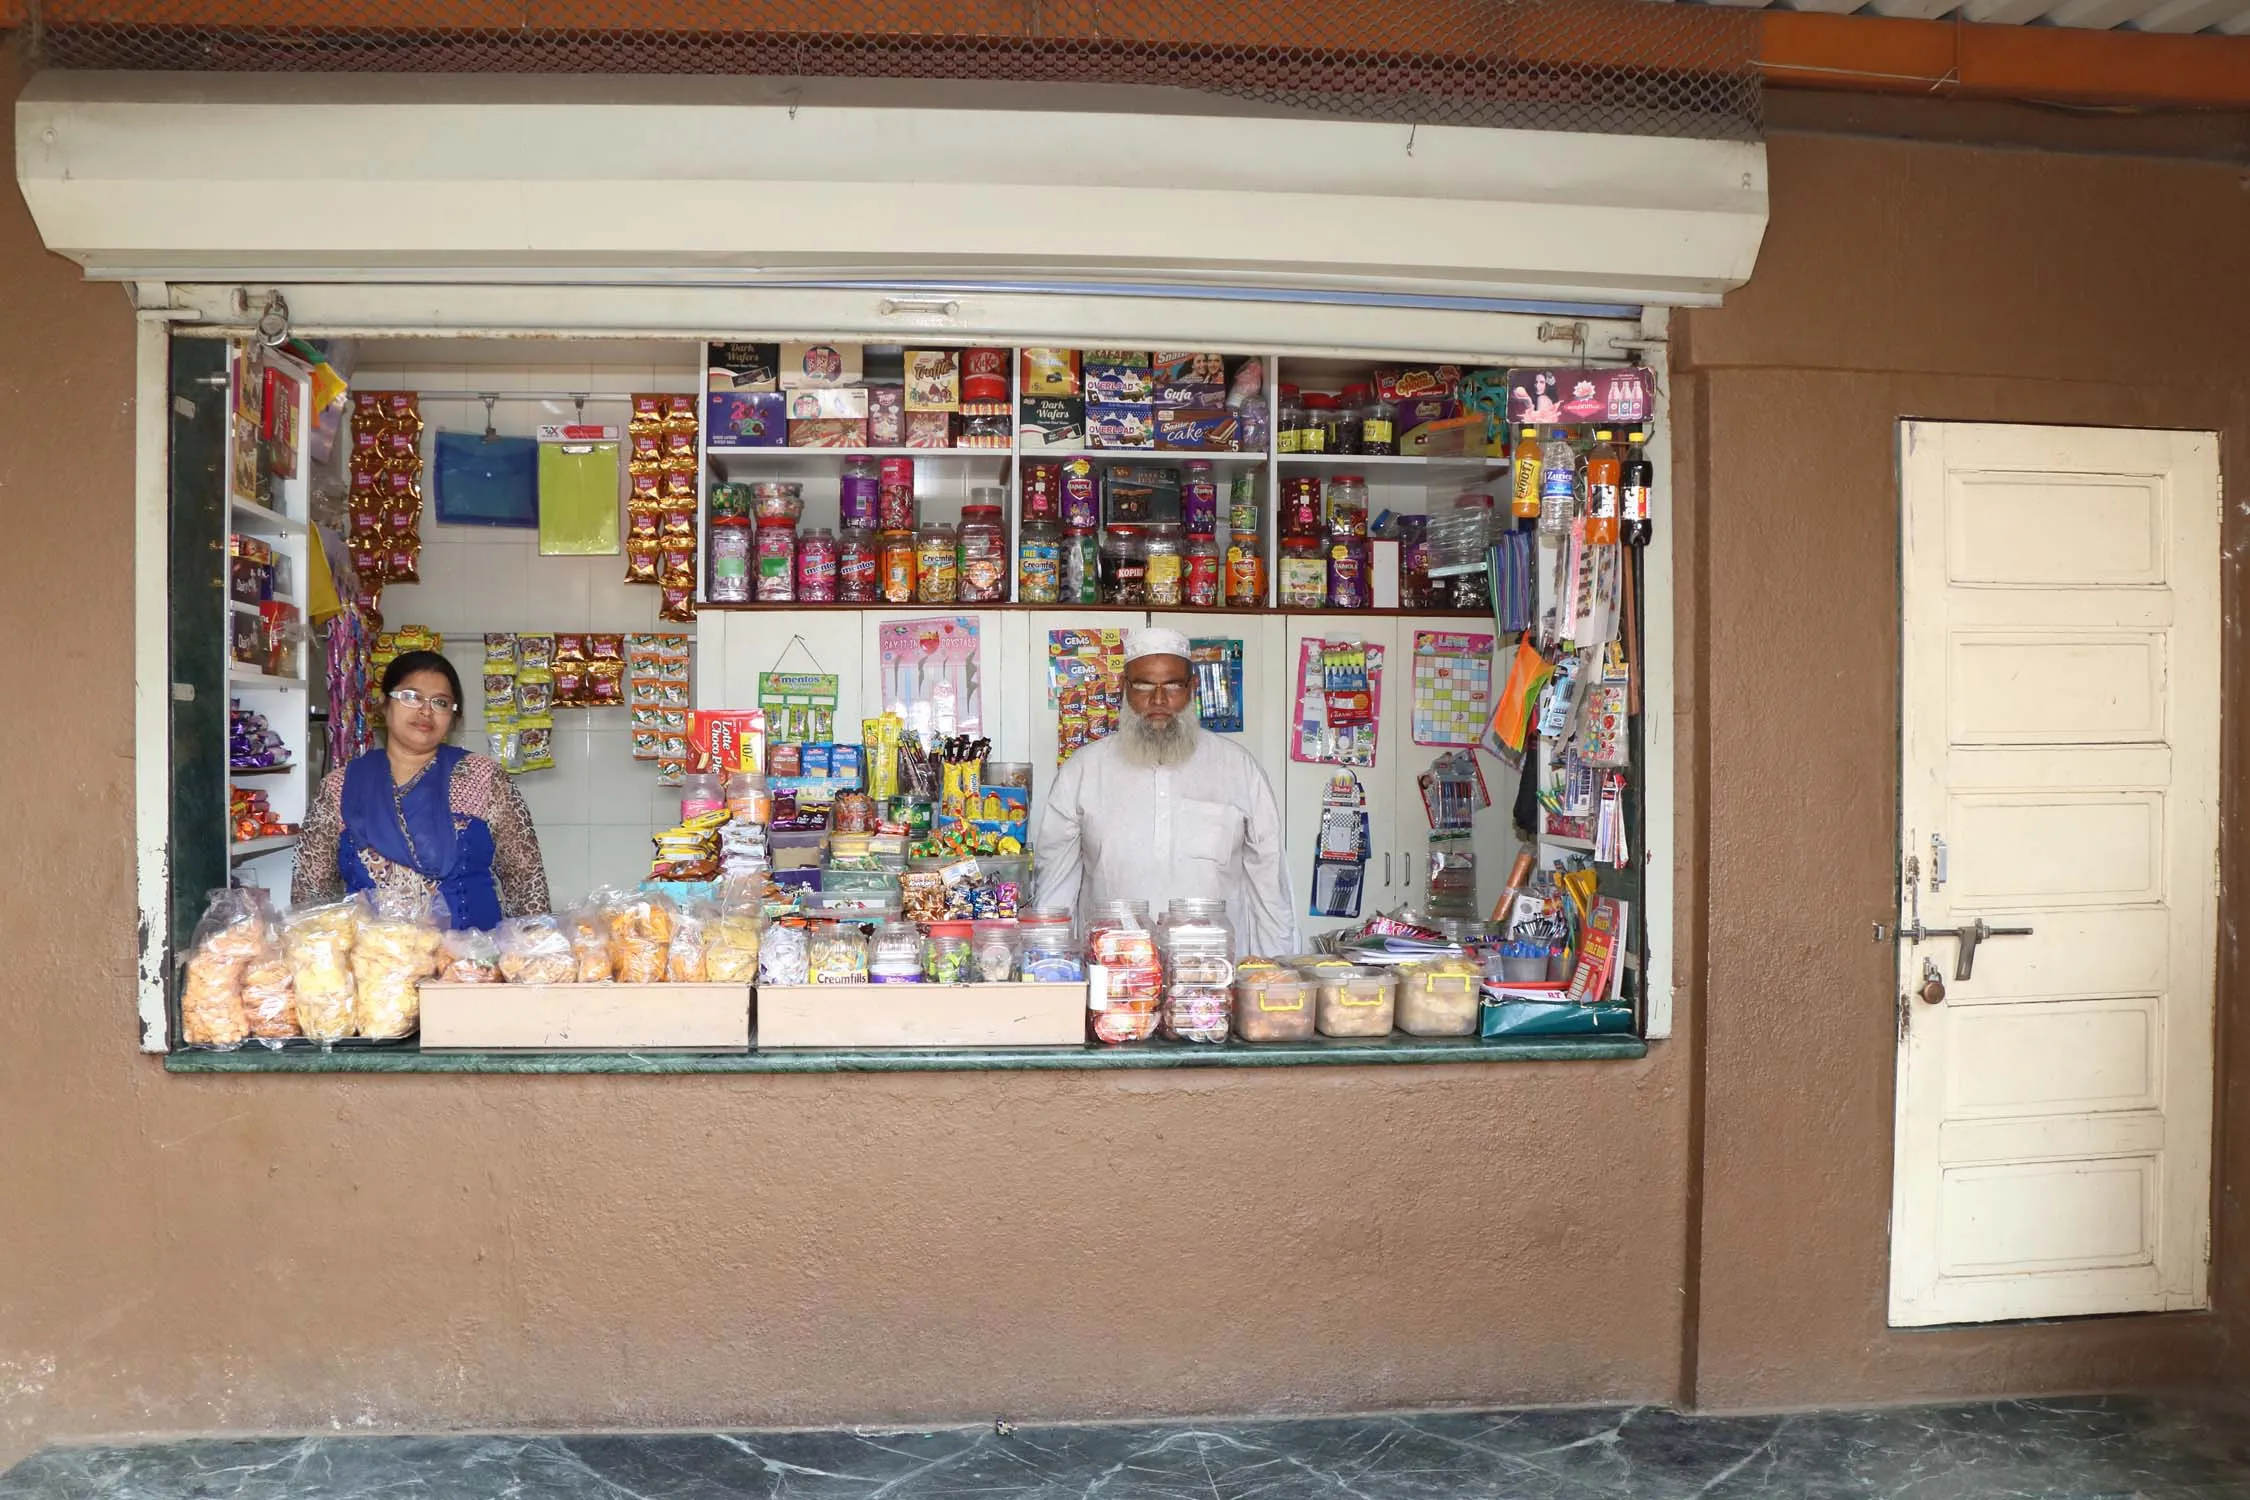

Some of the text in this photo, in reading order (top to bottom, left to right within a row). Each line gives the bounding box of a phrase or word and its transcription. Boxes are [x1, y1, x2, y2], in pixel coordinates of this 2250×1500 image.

[1164, 388, 1192, 401] Gufa
[1040, 401, 1065, 409] Dark
[1037, 409, 1069, 420] Wafers
[1167, 421, 1203, 442] cake
[806, 562, 836, 575] mento
[1064, 637, 1090, 645] GEMS
[1070, 665, 1096, 674] GEMS
[781, 676, 820, 684] mentos
[722, 720, 733, 750] Lotte
[711, 720, 722, 775] Choco Pie
[817, 972, 866, 984] Creamfills
